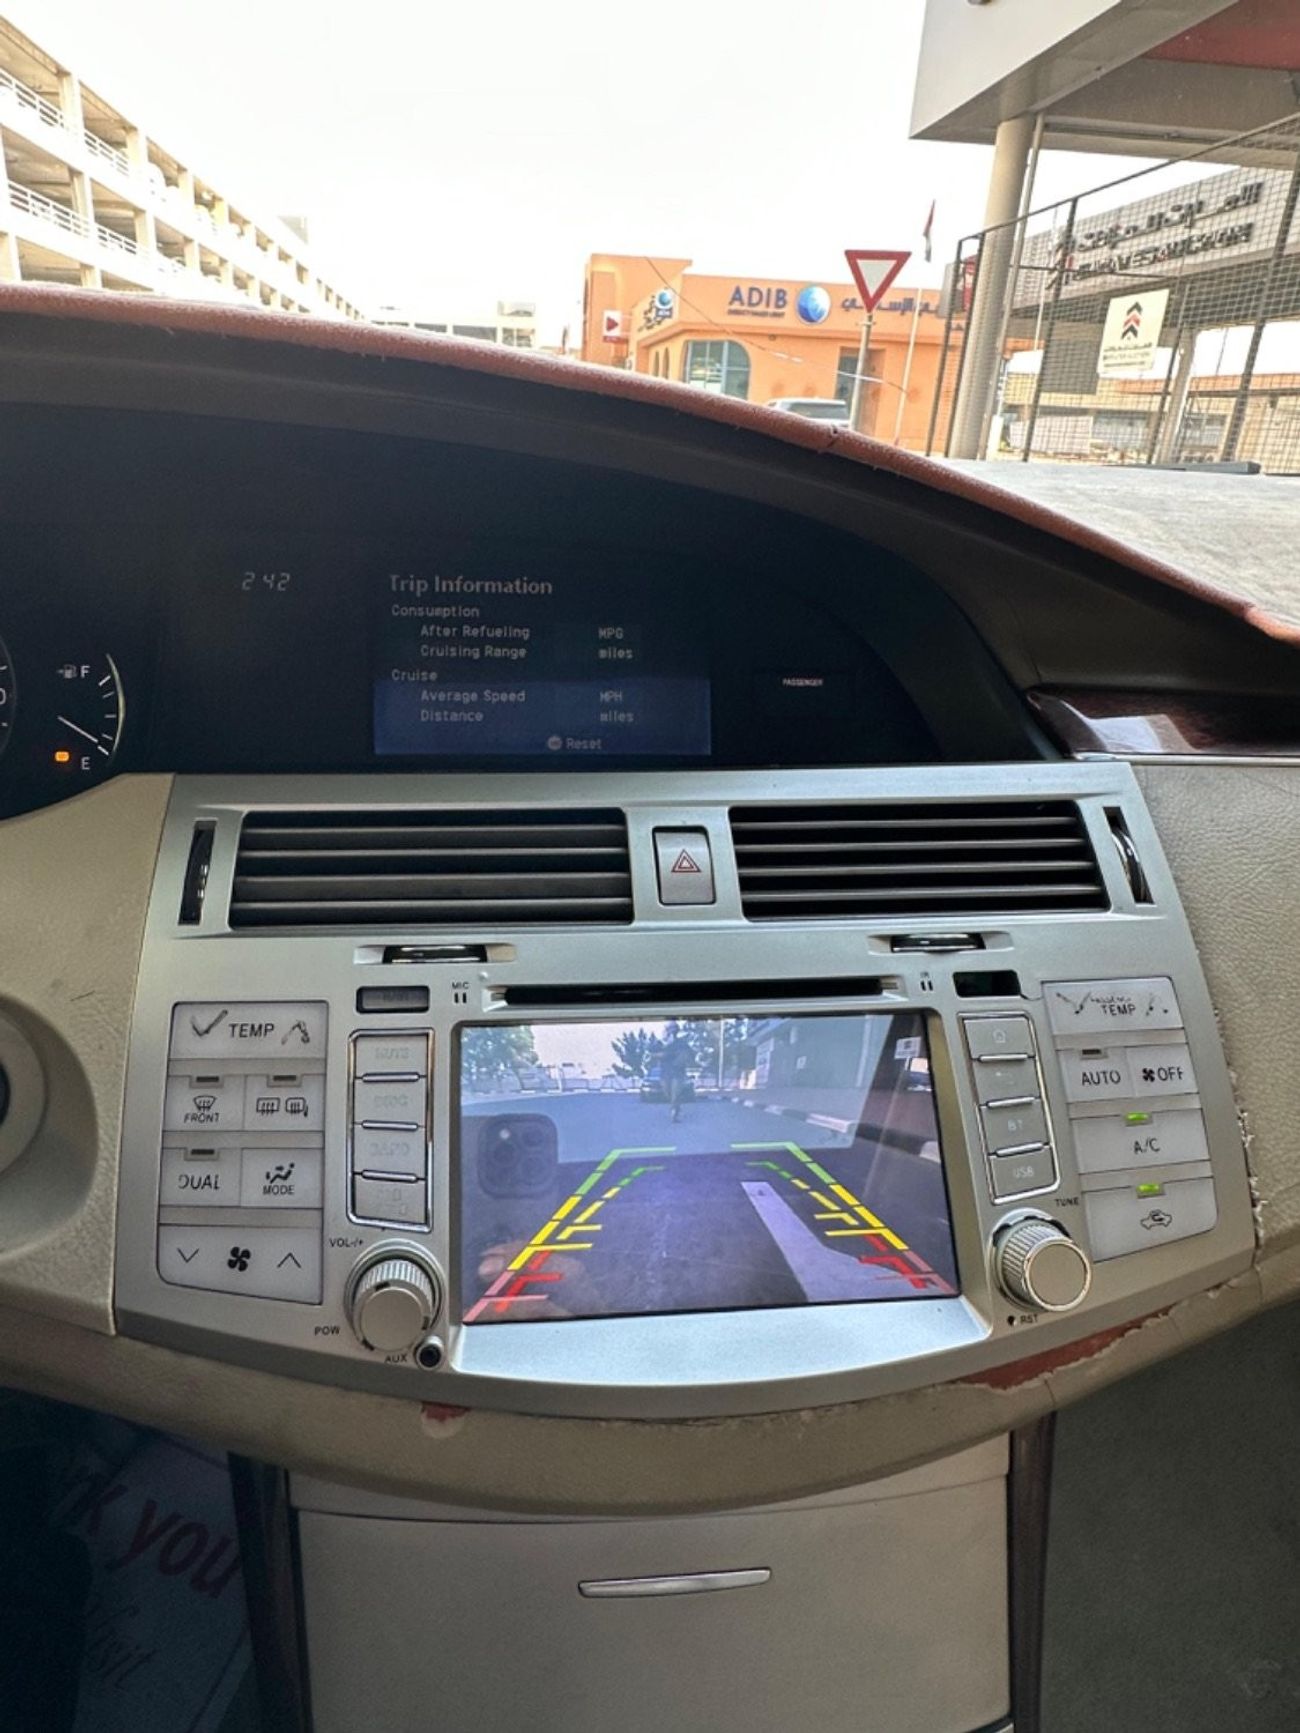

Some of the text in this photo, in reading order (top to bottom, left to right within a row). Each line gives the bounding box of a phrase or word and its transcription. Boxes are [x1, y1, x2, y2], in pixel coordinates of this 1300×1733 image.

[728, 285, 787, 309] ADIB
[390, 575, 553, 597] Trip Information
[391, 604, 480, 620] Consumption
[420, 625, 531, 641] After Refueling
[599, 627, 624, 640] MPG
[420, 645, 528, 660] Cruising Range
[598, 646, 634, 660] miles
[80, 665, 90, 678] F
[391, 668, 438, 682] Cruise
[420, 689, 526, 704] Average Speed
[599, 691, 624, 704] MPH
[420, 710, 484, 723] Distance
[599, 710, 635, 723] miles
[566, 737, 602, 750] Reset
[81, 757, 91, 771] E
[451, 981, 470, 990] MIC
[1101, 1003, 1137, 1018] TEMP
[228, 1022, 276, 1039] TEMP
[1081, 1071, 1122, 1086] AUTO
[1157, 1067, 1184, 1082] OFF
[183, 1111, 220, 1124] FRONT
[1133, 1138, 1160, 1154] A/C
[1012, 1165, 1034, 1179] USB
[179, 1174, 220, 1190] DUAL
[262, 1184, 296, 1197] MODE
[1054, 1197, 1080, 1207] TUNE
[1019, 1314, 1040, 1325] RST
[314, 1325, 340, 1336] POW
[384, 1353, 408, 1364] AUX
